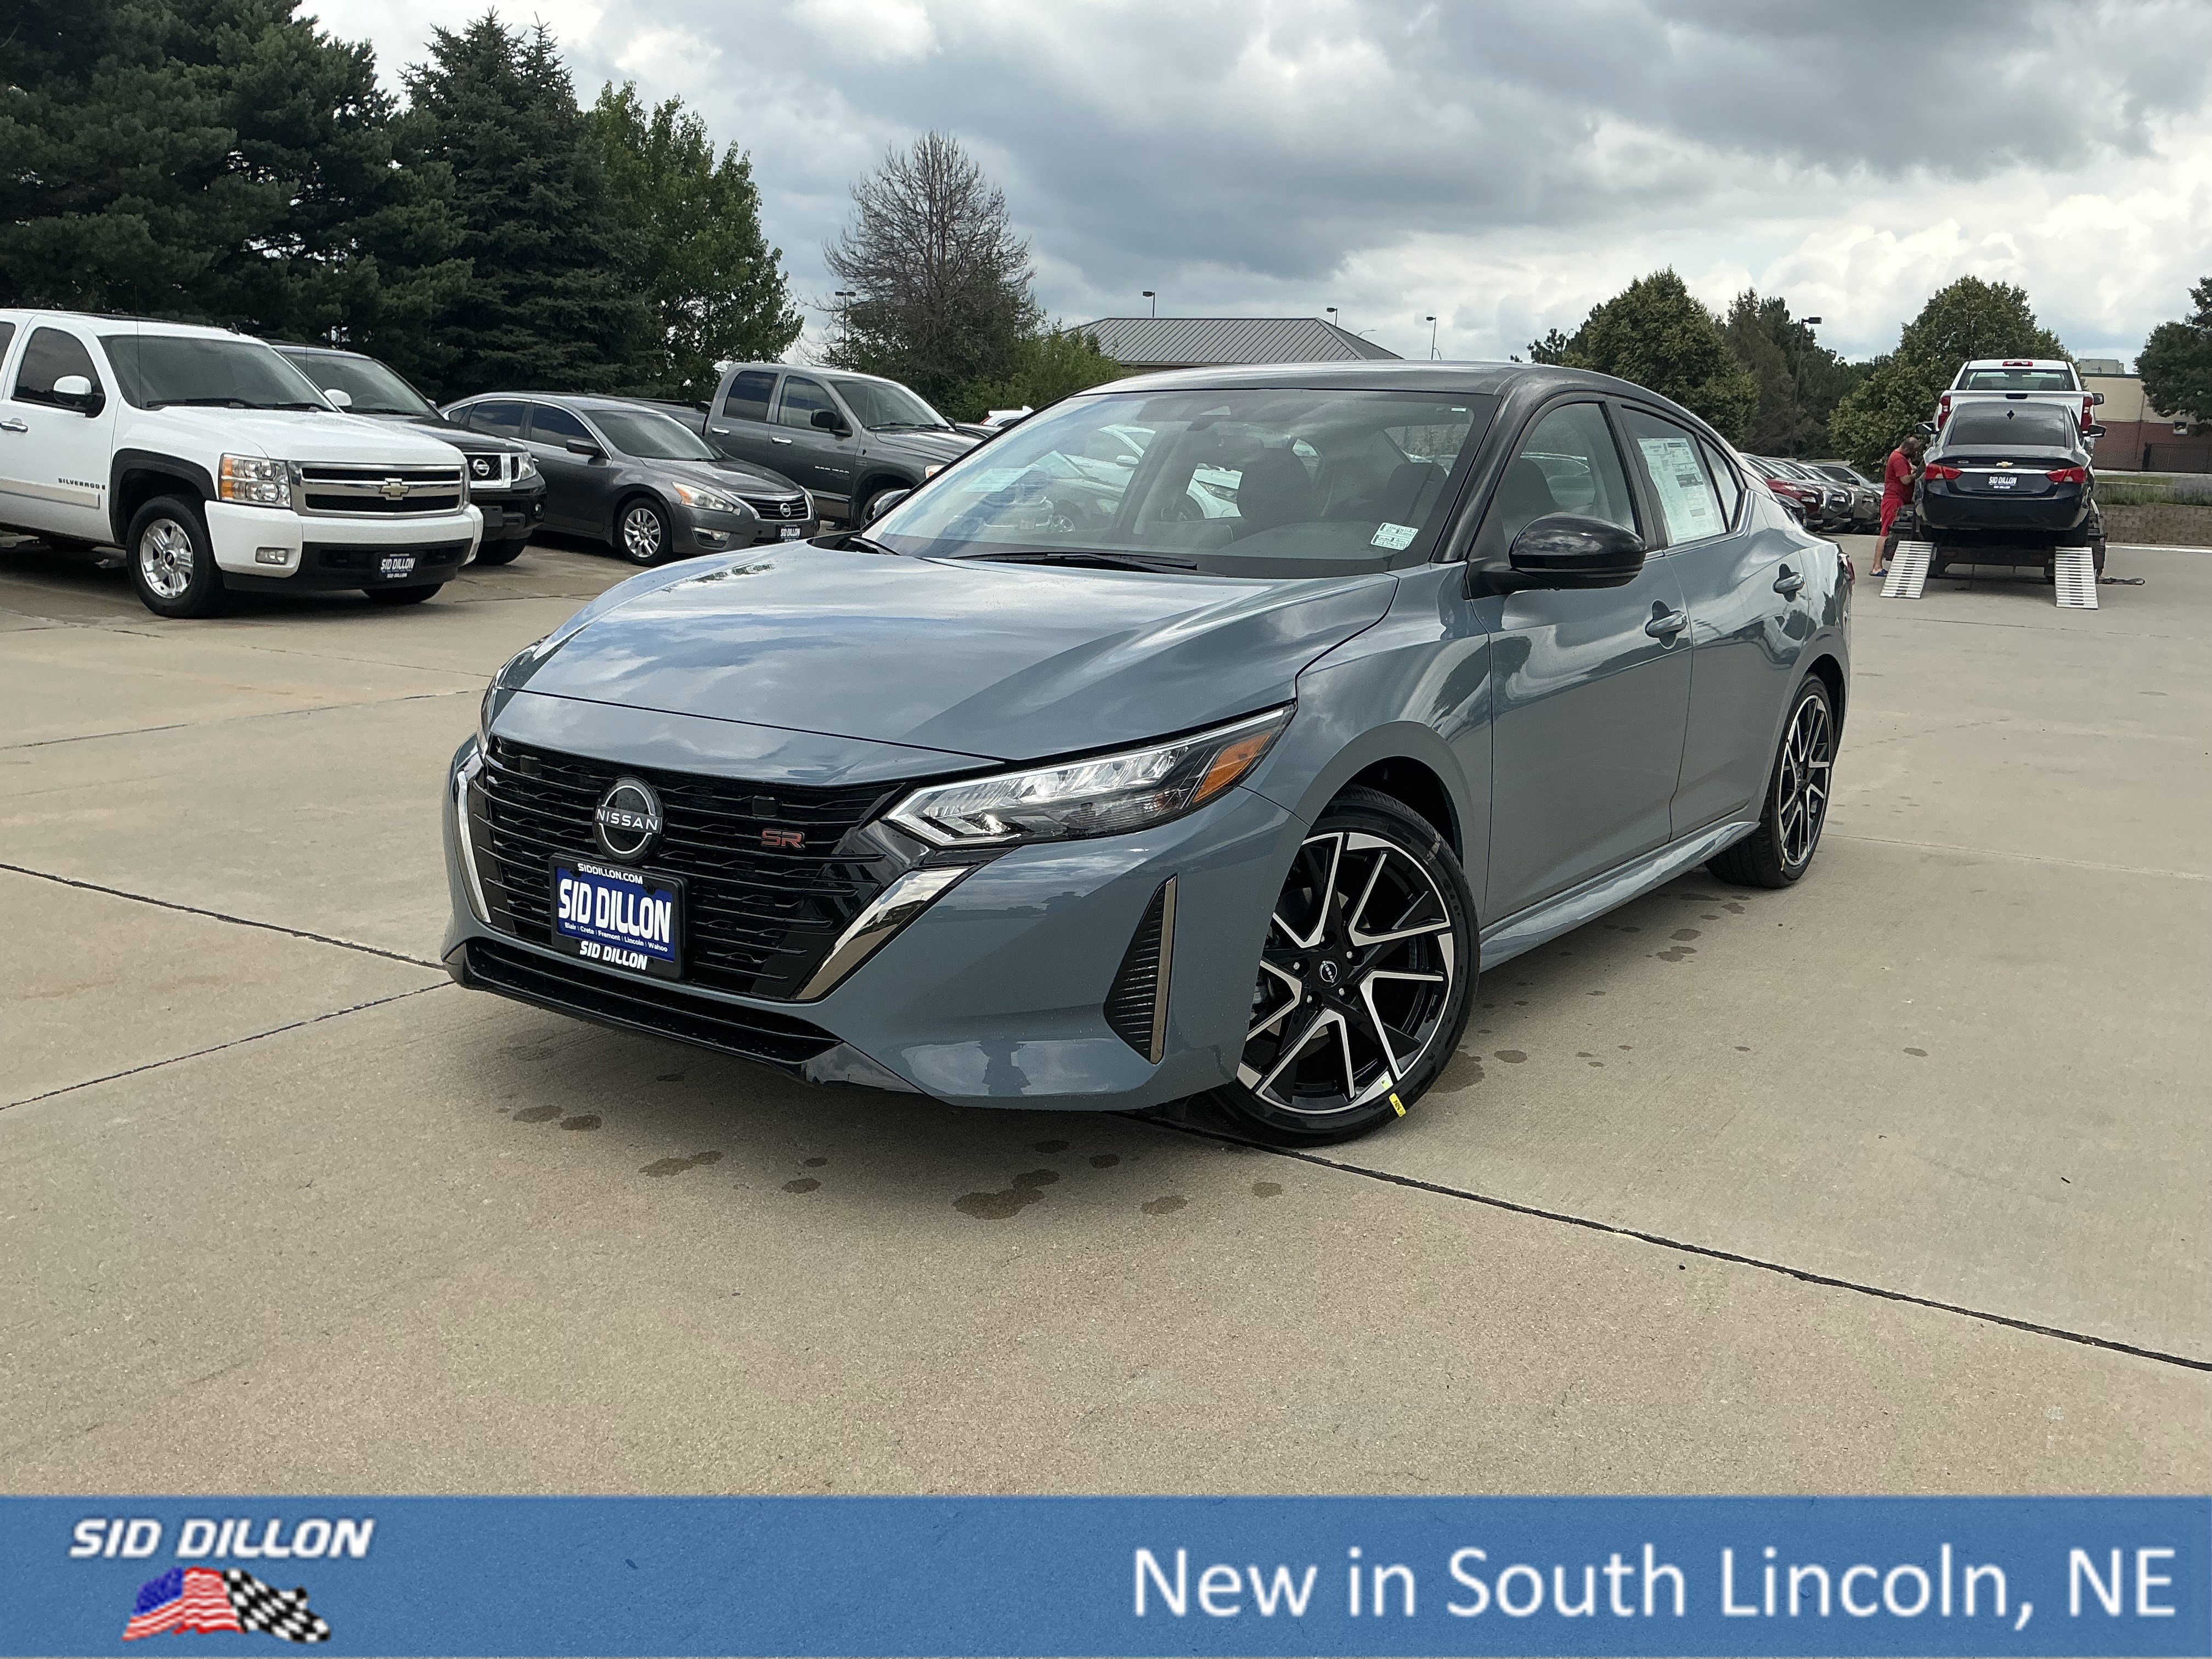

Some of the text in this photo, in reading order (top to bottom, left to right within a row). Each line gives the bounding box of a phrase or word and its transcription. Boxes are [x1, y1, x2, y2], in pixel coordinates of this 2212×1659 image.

[380, 557, 416, 571] SID DILLON
[596, 808, 658, 831] NISSAN
[761, 829, 804, 849] SR
[577, 862, 644, 885] SIDDILLON.COM
[558, 878, 672, 944] SID DILLON
[565, 922, 668, 952] Blair Crete Fremont Lincoln Wahoo
[579, 940, 648, 970] SID DILLON
